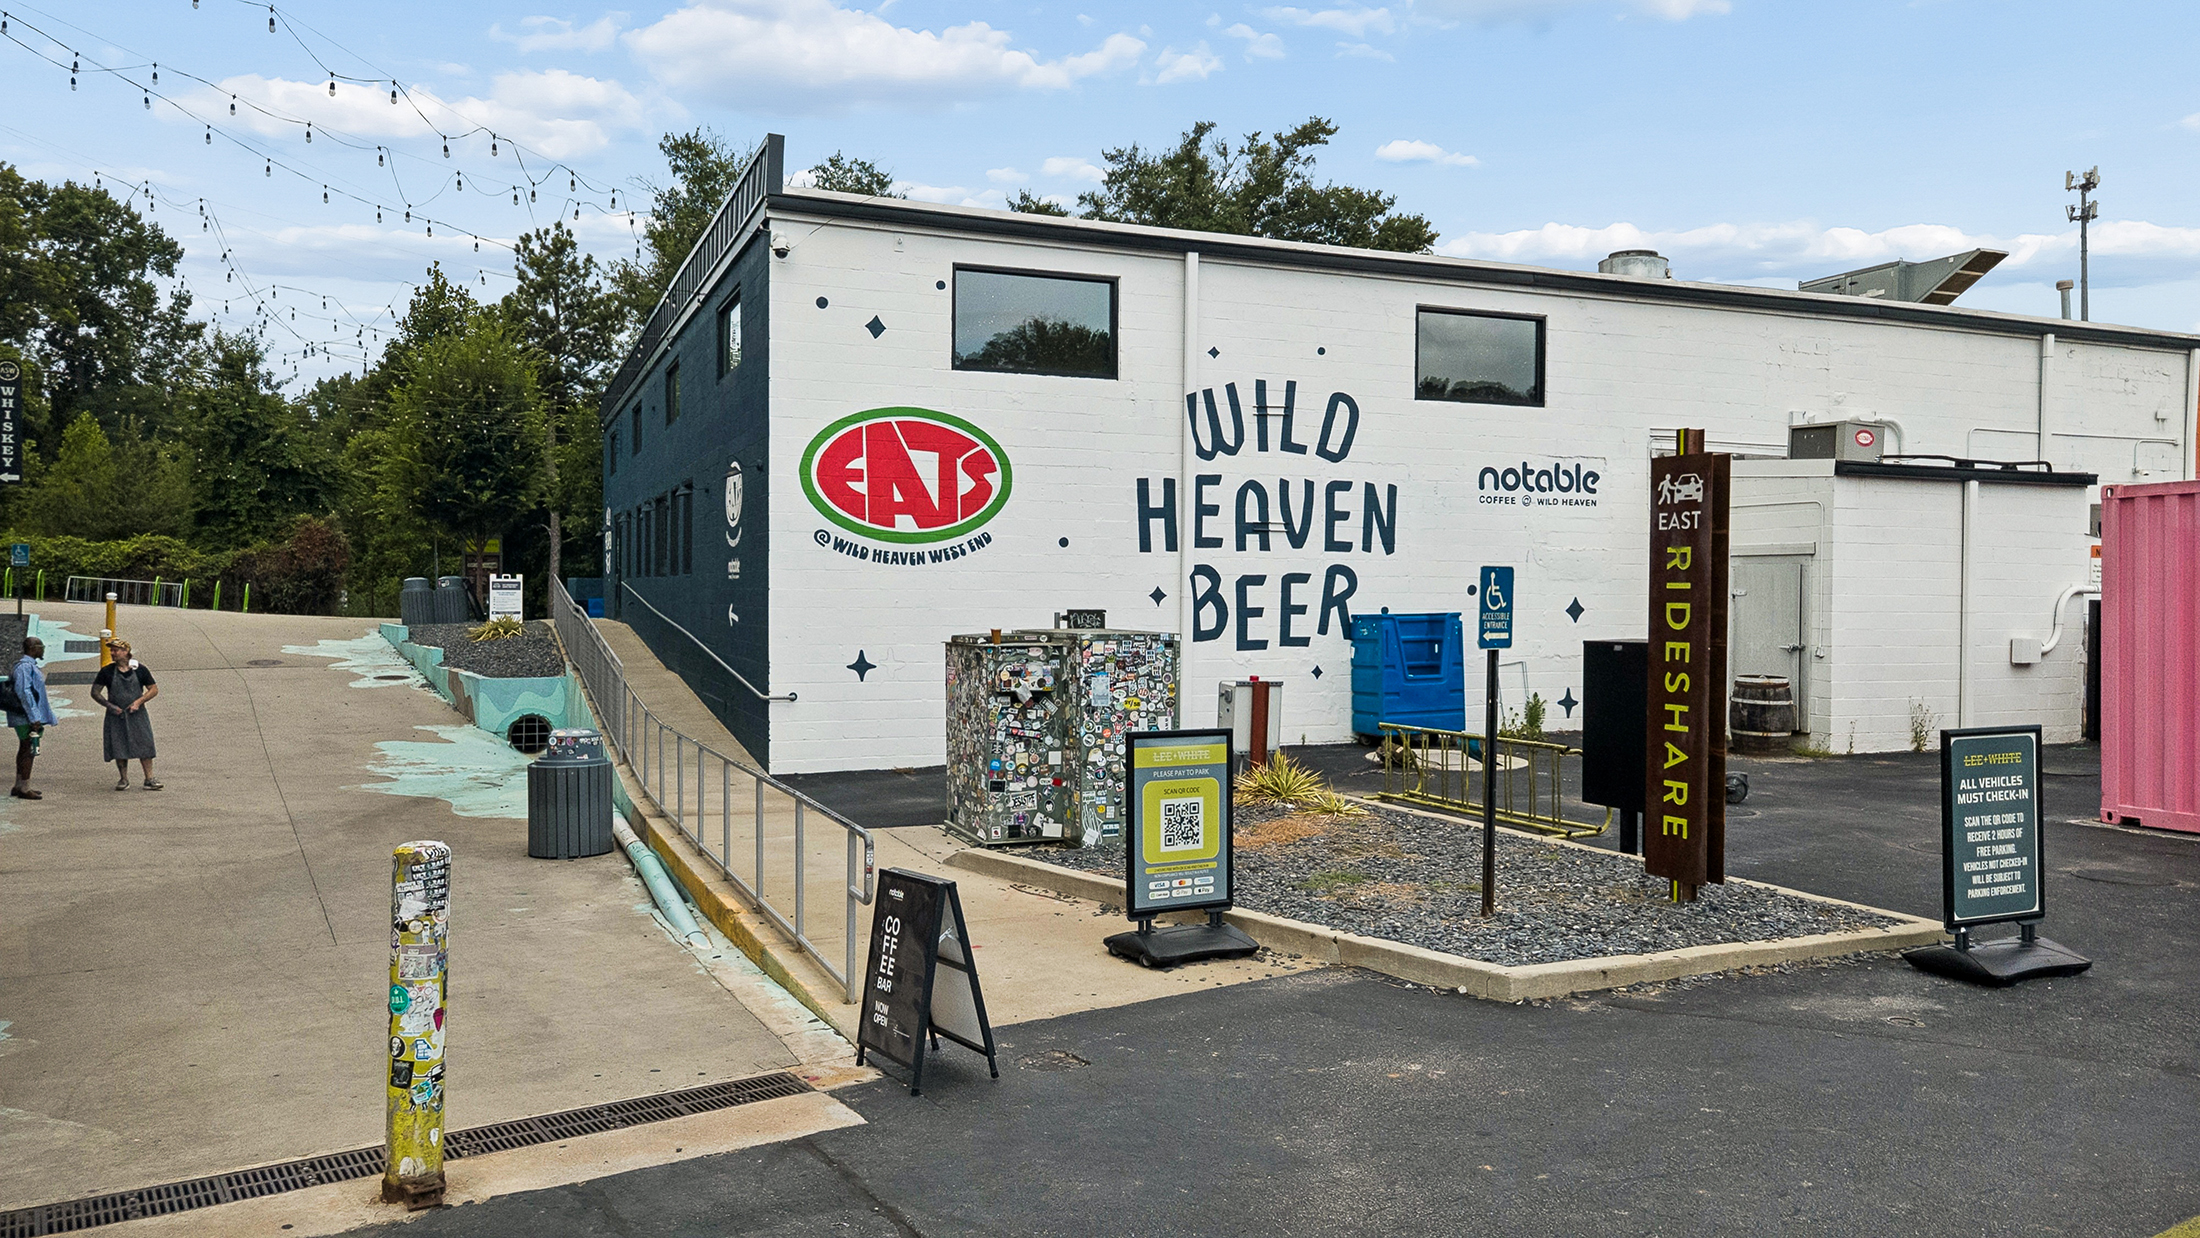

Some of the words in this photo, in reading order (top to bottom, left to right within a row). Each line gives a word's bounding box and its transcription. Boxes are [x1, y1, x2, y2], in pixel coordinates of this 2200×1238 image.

[1, 386, 15, 467] WHISKEY
[1186, 379, 1360, 463] WILD
[816, 420, 998, 529] EATS
[1478, 461, 1600, 494] notable
[1479, 495, 1516, 505] COFFEE
[1537, 498, 1559, 506] WILD
[1561, 498, 1597, 507] HEAVEN
[1136, 474, 1398, 555] HEAVEN
[1658, 511, 1701, 531] EAST
[813, 529, 831, 547] @
[832, 536, 869, 560] WILD
[872, 549, 926, 566] HEAVEN
[928, 543, 967, 564] WEST
[967, 531, 993, 552] END
[1189, 564, 1358, 651] BEER
[1482, 612, 1510, 620] ACCESSIBLE
[1483, 621, 1508, 629] ENTRANCE
[1663, 545, 1692, 841] RIDESHARE
[1153, 770, 1174, 778] PLEASE
[1959, 778, 1977, 790] ALL
[1979, 775, 2023, 789] VEHICLES
[1957, 792, 1984, 804] MUST
[1986, 789, 2029, 802] CHECK-IN
[1964, 816, 1980, 827] SCAN
[1980, 815, 1992, 826] THE
[1992, 814, 2001, 825] QR
[2001, 813, 2016, 824] CODE
[2017, 812, 2024, 823] TO
[1967, 831, 1991, 842] RECEIVE
[1992, 830, 1996, 840] 2
[1997, 828, 2015, 840] HOURS
[2016, 828, 2023, 838] OF
[1976, 846, 1991, 857] FREE
[1963, 861, 1988, 872] VEHICLES
[1989, 859, 1999, 869] NOT
[1999, 856, 2028, 868] CHECKED-IN
[1972, 874, 1985, 884] WILL
[1985, 873, 1993, 883] BE
[1993, 871, 2014, 882] SUBJECT
[2014, 871, 2021, 880] TO
[1967, 887, 1990, 899] PARKING
[876, 976, 892, 993] BAR
[874, 1000, 890, 1016] NOW
[873, 1012, 888, 1028] OPEN
